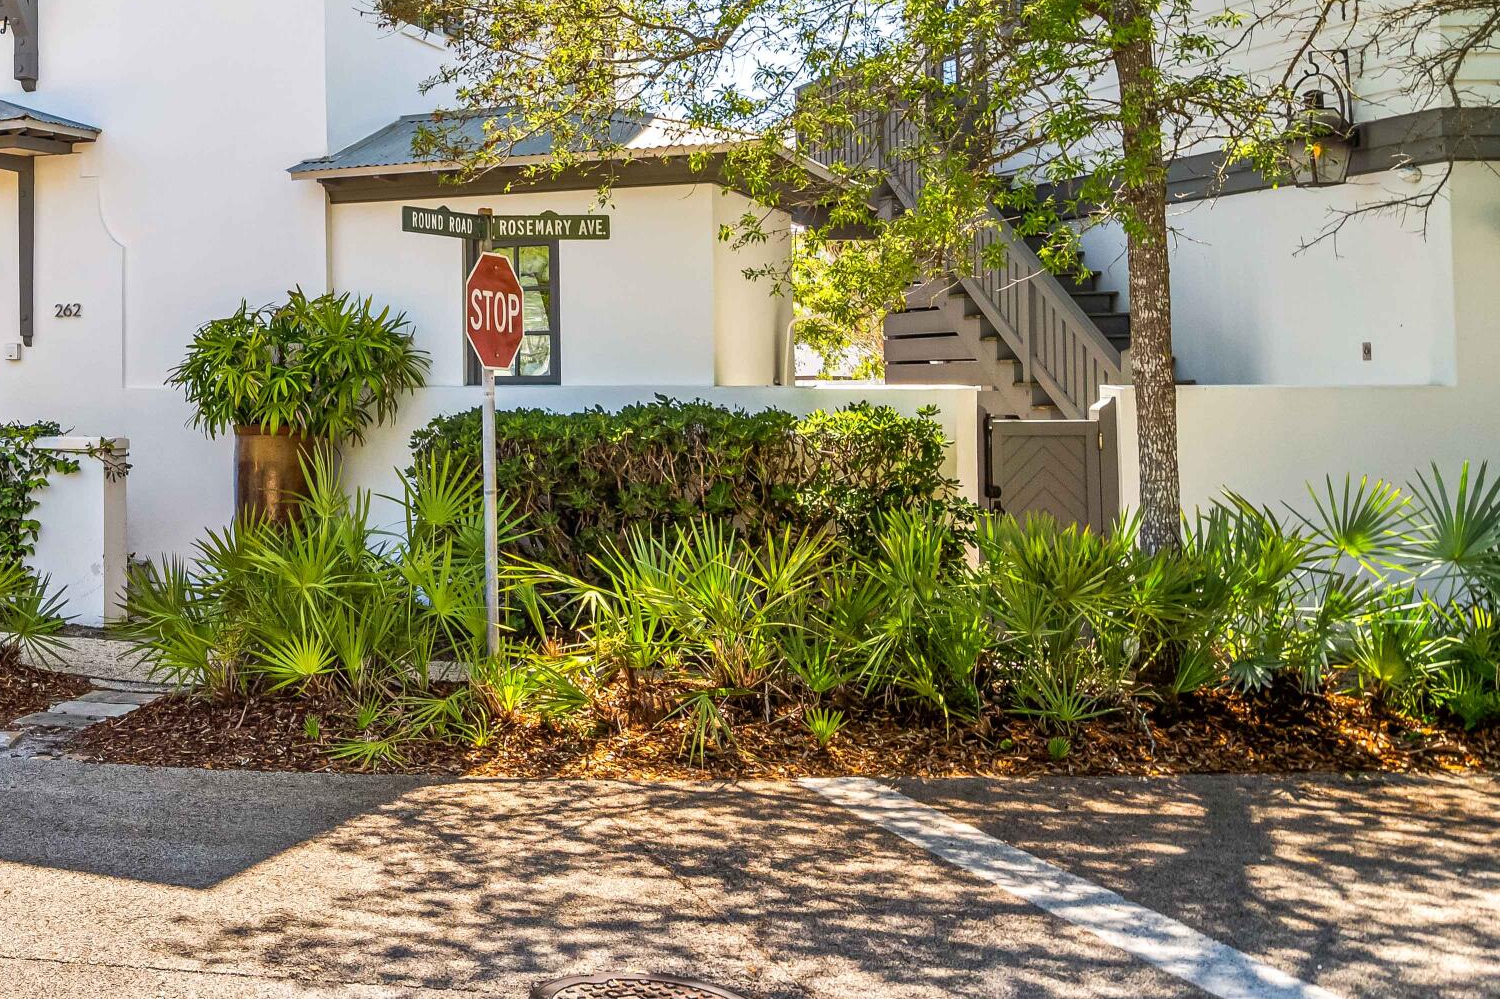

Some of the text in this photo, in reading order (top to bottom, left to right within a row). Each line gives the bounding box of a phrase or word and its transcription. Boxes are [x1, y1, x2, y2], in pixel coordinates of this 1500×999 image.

[412, 211, 473, 235] ROUND ROAD
[500, 219, 607, 236] ROSEMARY AVE.
[54, 303, 82, 318] 262
[470, 288, 520, 333] STOP
